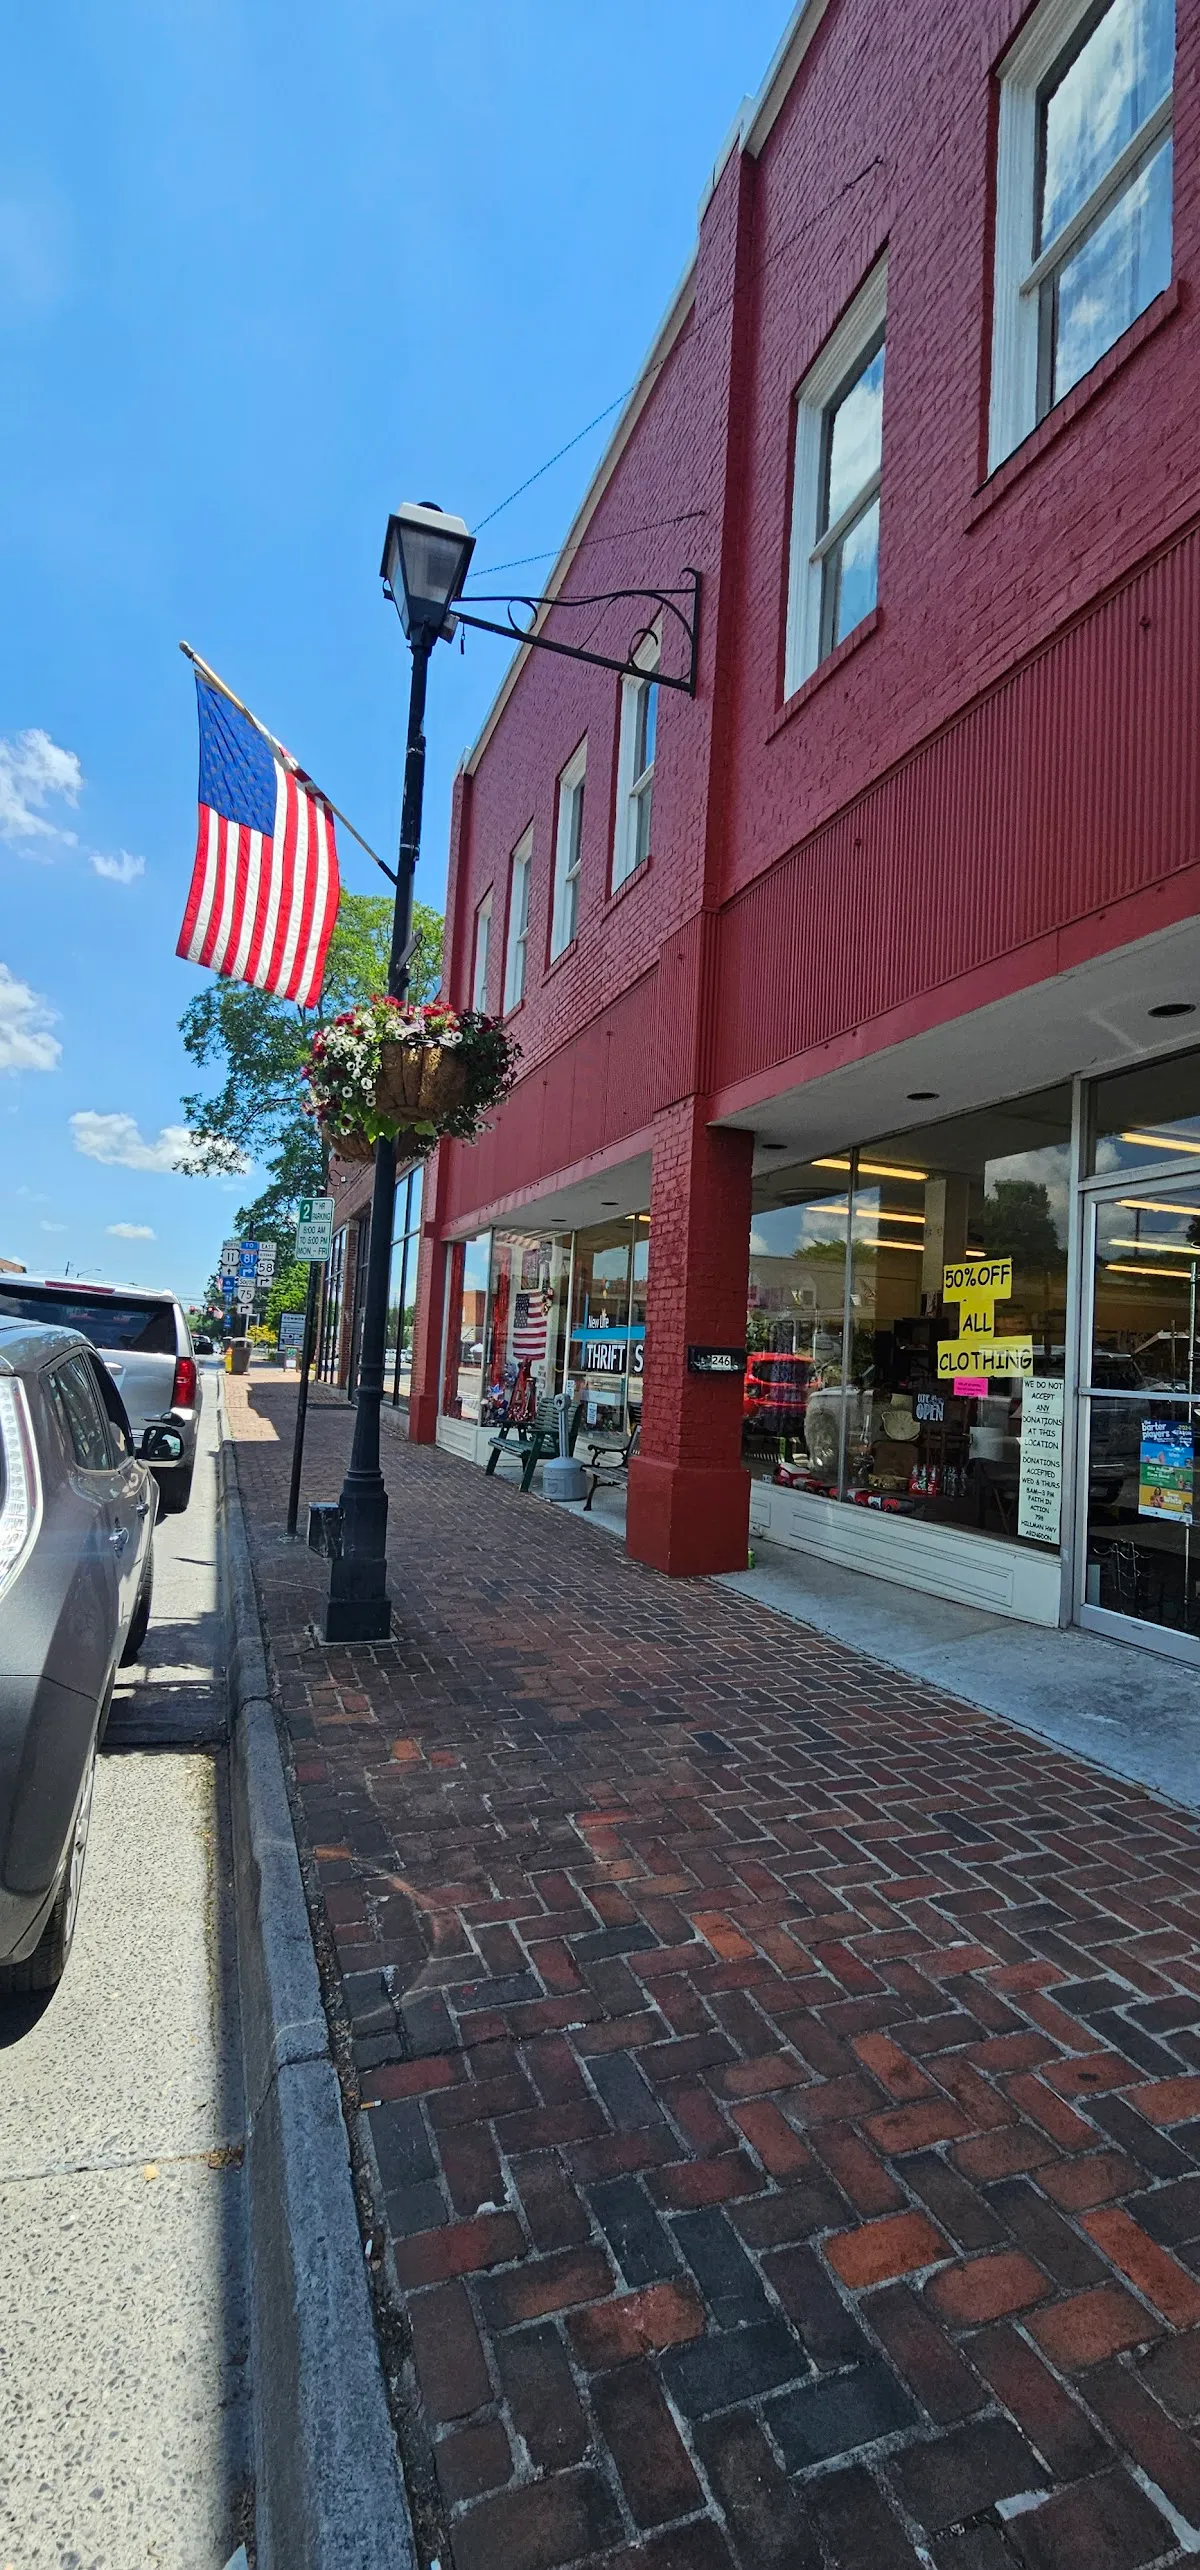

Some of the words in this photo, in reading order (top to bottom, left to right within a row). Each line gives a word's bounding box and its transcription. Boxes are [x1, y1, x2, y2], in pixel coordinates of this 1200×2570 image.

[303, 1203, 310, 1219] 2
[312, 1212, 331, 1221] PARKING
[317, 1225, 326, 1234] AM
[300, 1236, 307, 1245] TO
[307, 1236, 319, 1245] 5:00
[320, 1236, 328, 1245] PM
[318, 1246, 327, 1256] FRI
[227, 1252, 234, 1262] 11
[243, 1254, 254, 1264] 81
[260, 1263, 273, 1273] 58
[240, 1289, 252, 1300] 75
[588, 1315, 600, 1329] New
[600, 1314, 610, 1329] Life
[962, 1312, 992, 1333] ALL
[587, 1344, 626, 1371] THRIFT
[712, 1356, 730, 1366] 246
[939, 1348, 1033, 1372] CLOTHING
[1048, 1382, 1063, 1390] NOT
[1031, 1392, 1055, 1400] ACCEPT
[915, 1403, 945, 1422] OPEN
[1035, 1404, 1050, 1412] ANY
[1023, 1415, 1063, 1426] DONATIONS
[1141, 1422, 1167, 1432] barter
[1039, 1428, 1055, 1438] THIS
[1142, 1430, 1171, 1441] players
[1024, 1439, 1059, 1449] LOCATION
[1022, 1456, 1060, 1468] DONATIONS
[1026, 1468, 1056, 1479] ACCEPTED
[1022, 1477, 1034, 1485] WED
[1042, 1480, 1060, 1489] THURS
[1027, 1495, 1044, 1503] FAITH
[1030, 1505, 1050, 1514] ACTION
[1021, 1520, 1044, 1530] HILLMAN
[1045, 1525, 1057, 1533] HWY
[1025, 1530, 1052, 1541] ABINGDON
